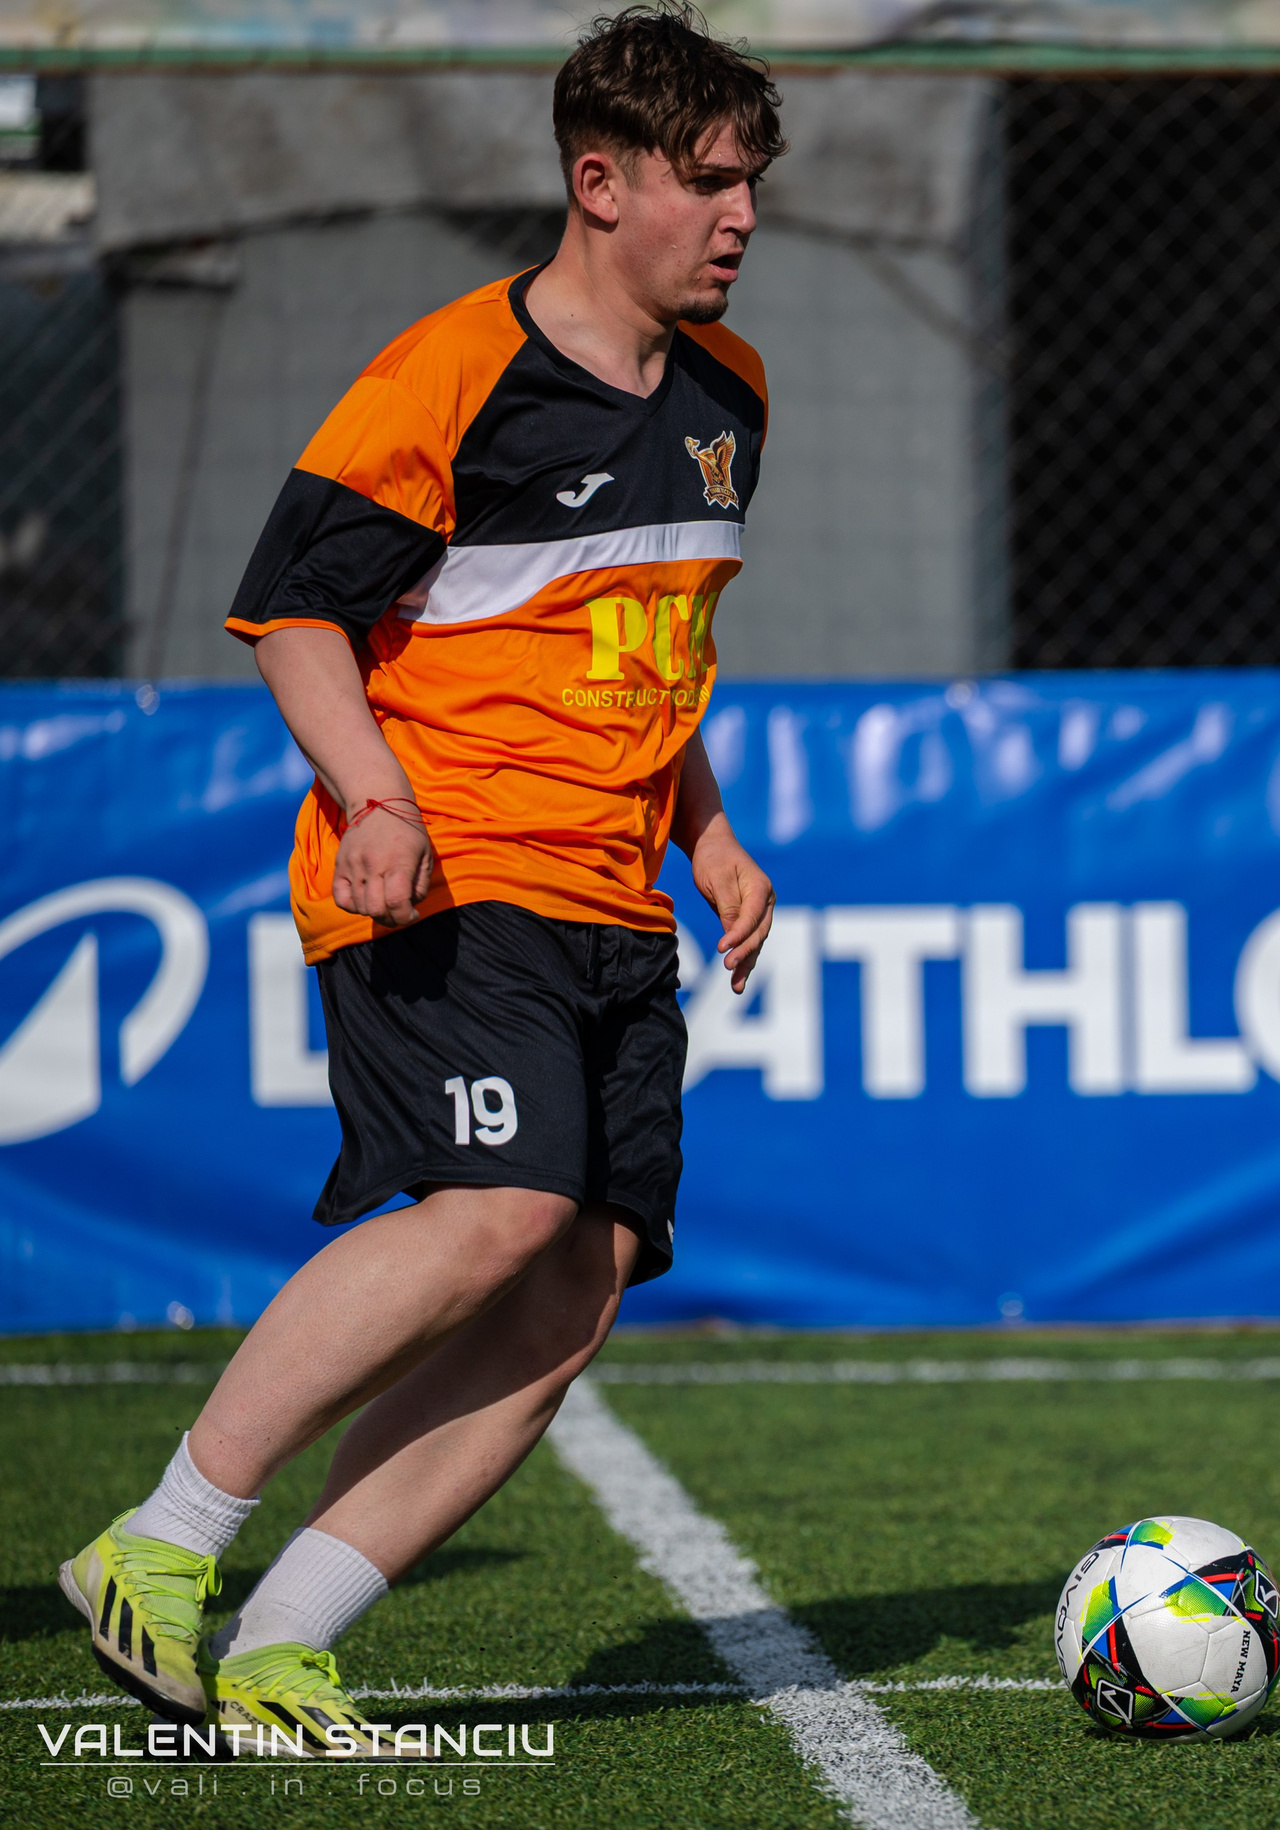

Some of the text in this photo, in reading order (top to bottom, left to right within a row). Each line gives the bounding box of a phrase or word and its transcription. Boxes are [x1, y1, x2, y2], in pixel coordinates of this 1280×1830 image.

[445, 1075, 519, 1146] 19
[1230, 1629, 1252, 1693] NEW MAYA
